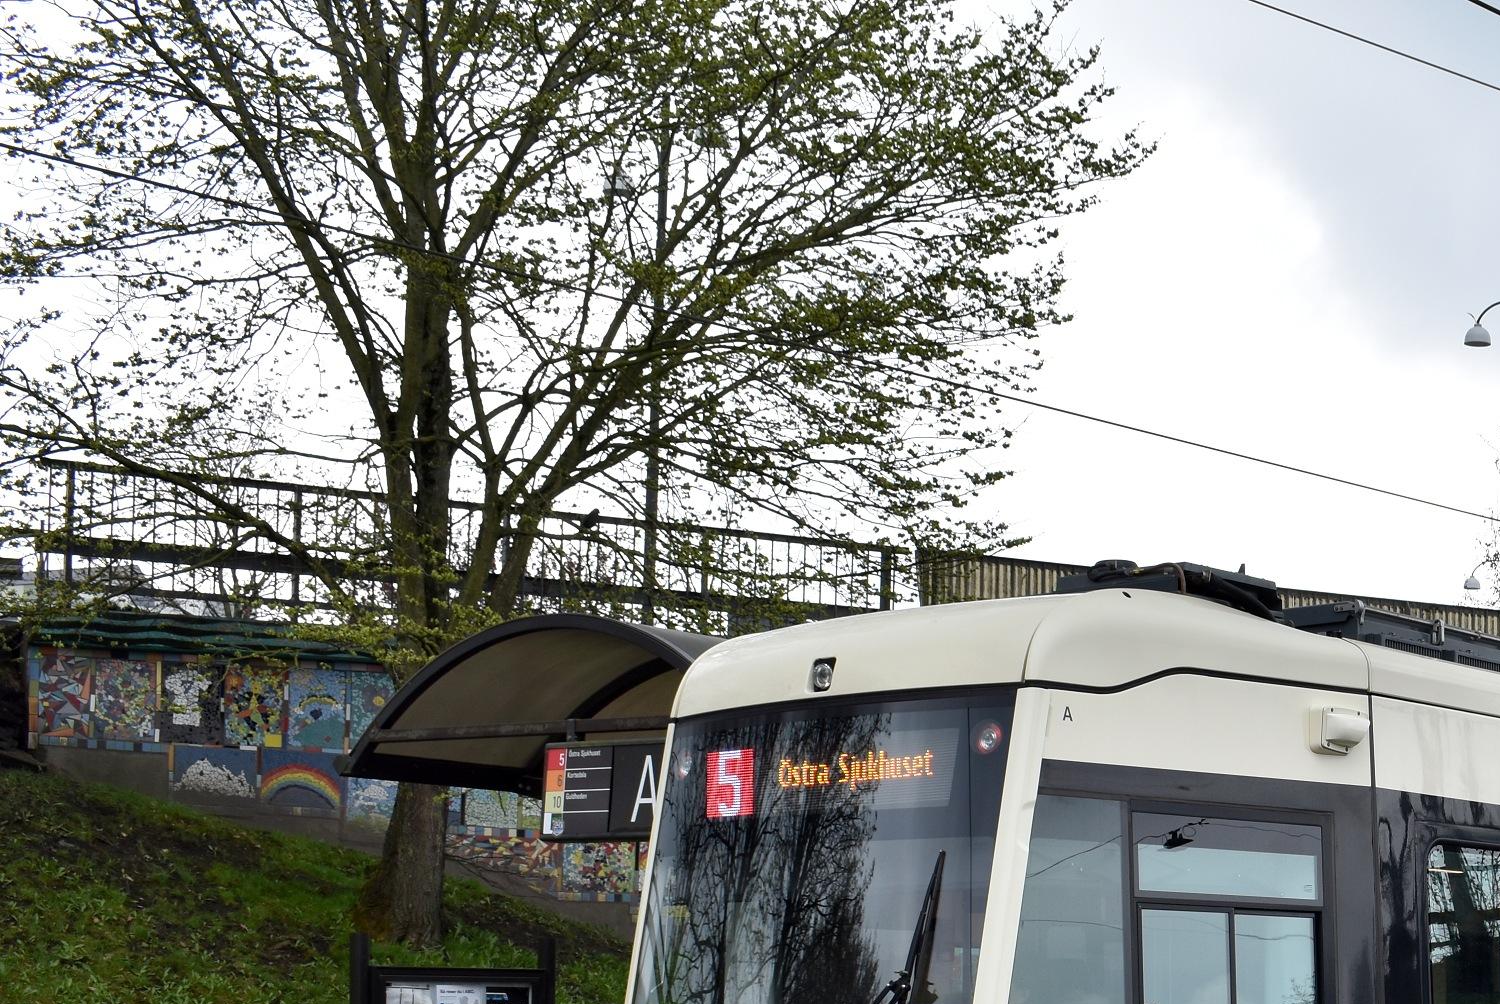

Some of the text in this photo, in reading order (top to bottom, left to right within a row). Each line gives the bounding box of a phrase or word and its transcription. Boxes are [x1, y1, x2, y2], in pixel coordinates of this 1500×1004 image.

[1062, 706, 1073, 721] A
[559, 753, 565, 766] 5
[557, 775, 563, 787] 6
[717, 749, 934, 817] 5 Östra Sjukhuset
[630, 754, 656, 823] A
[553, 796, 562, 808] 10
